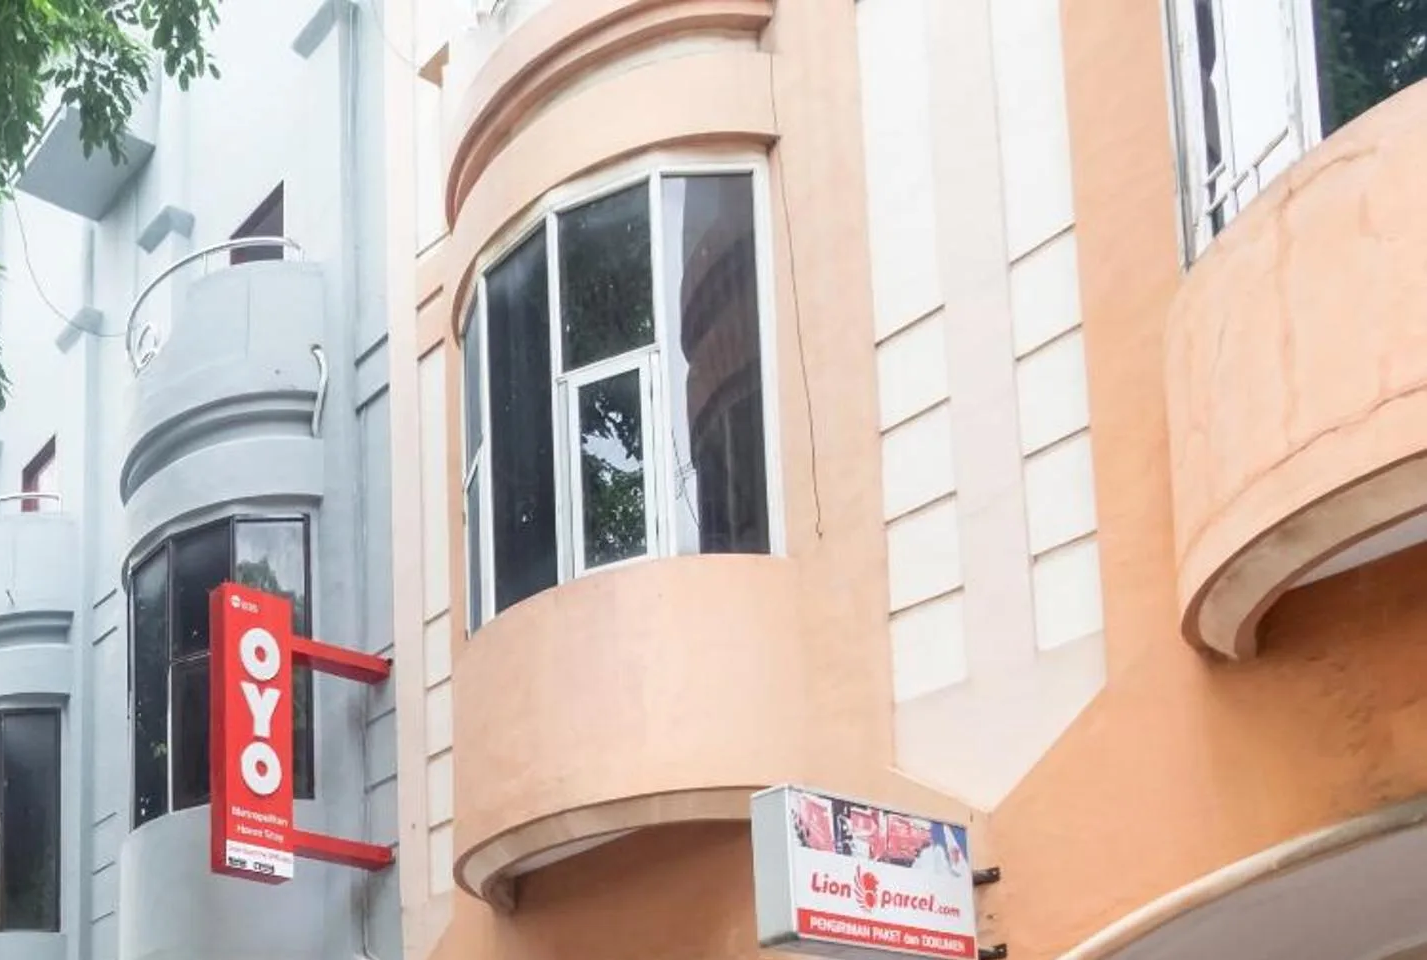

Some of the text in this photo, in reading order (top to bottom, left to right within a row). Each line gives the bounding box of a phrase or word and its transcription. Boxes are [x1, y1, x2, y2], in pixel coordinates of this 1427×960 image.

[239, 627, 282, 795] OYO
[811, 871, 961, 918] Lion parcel.com
